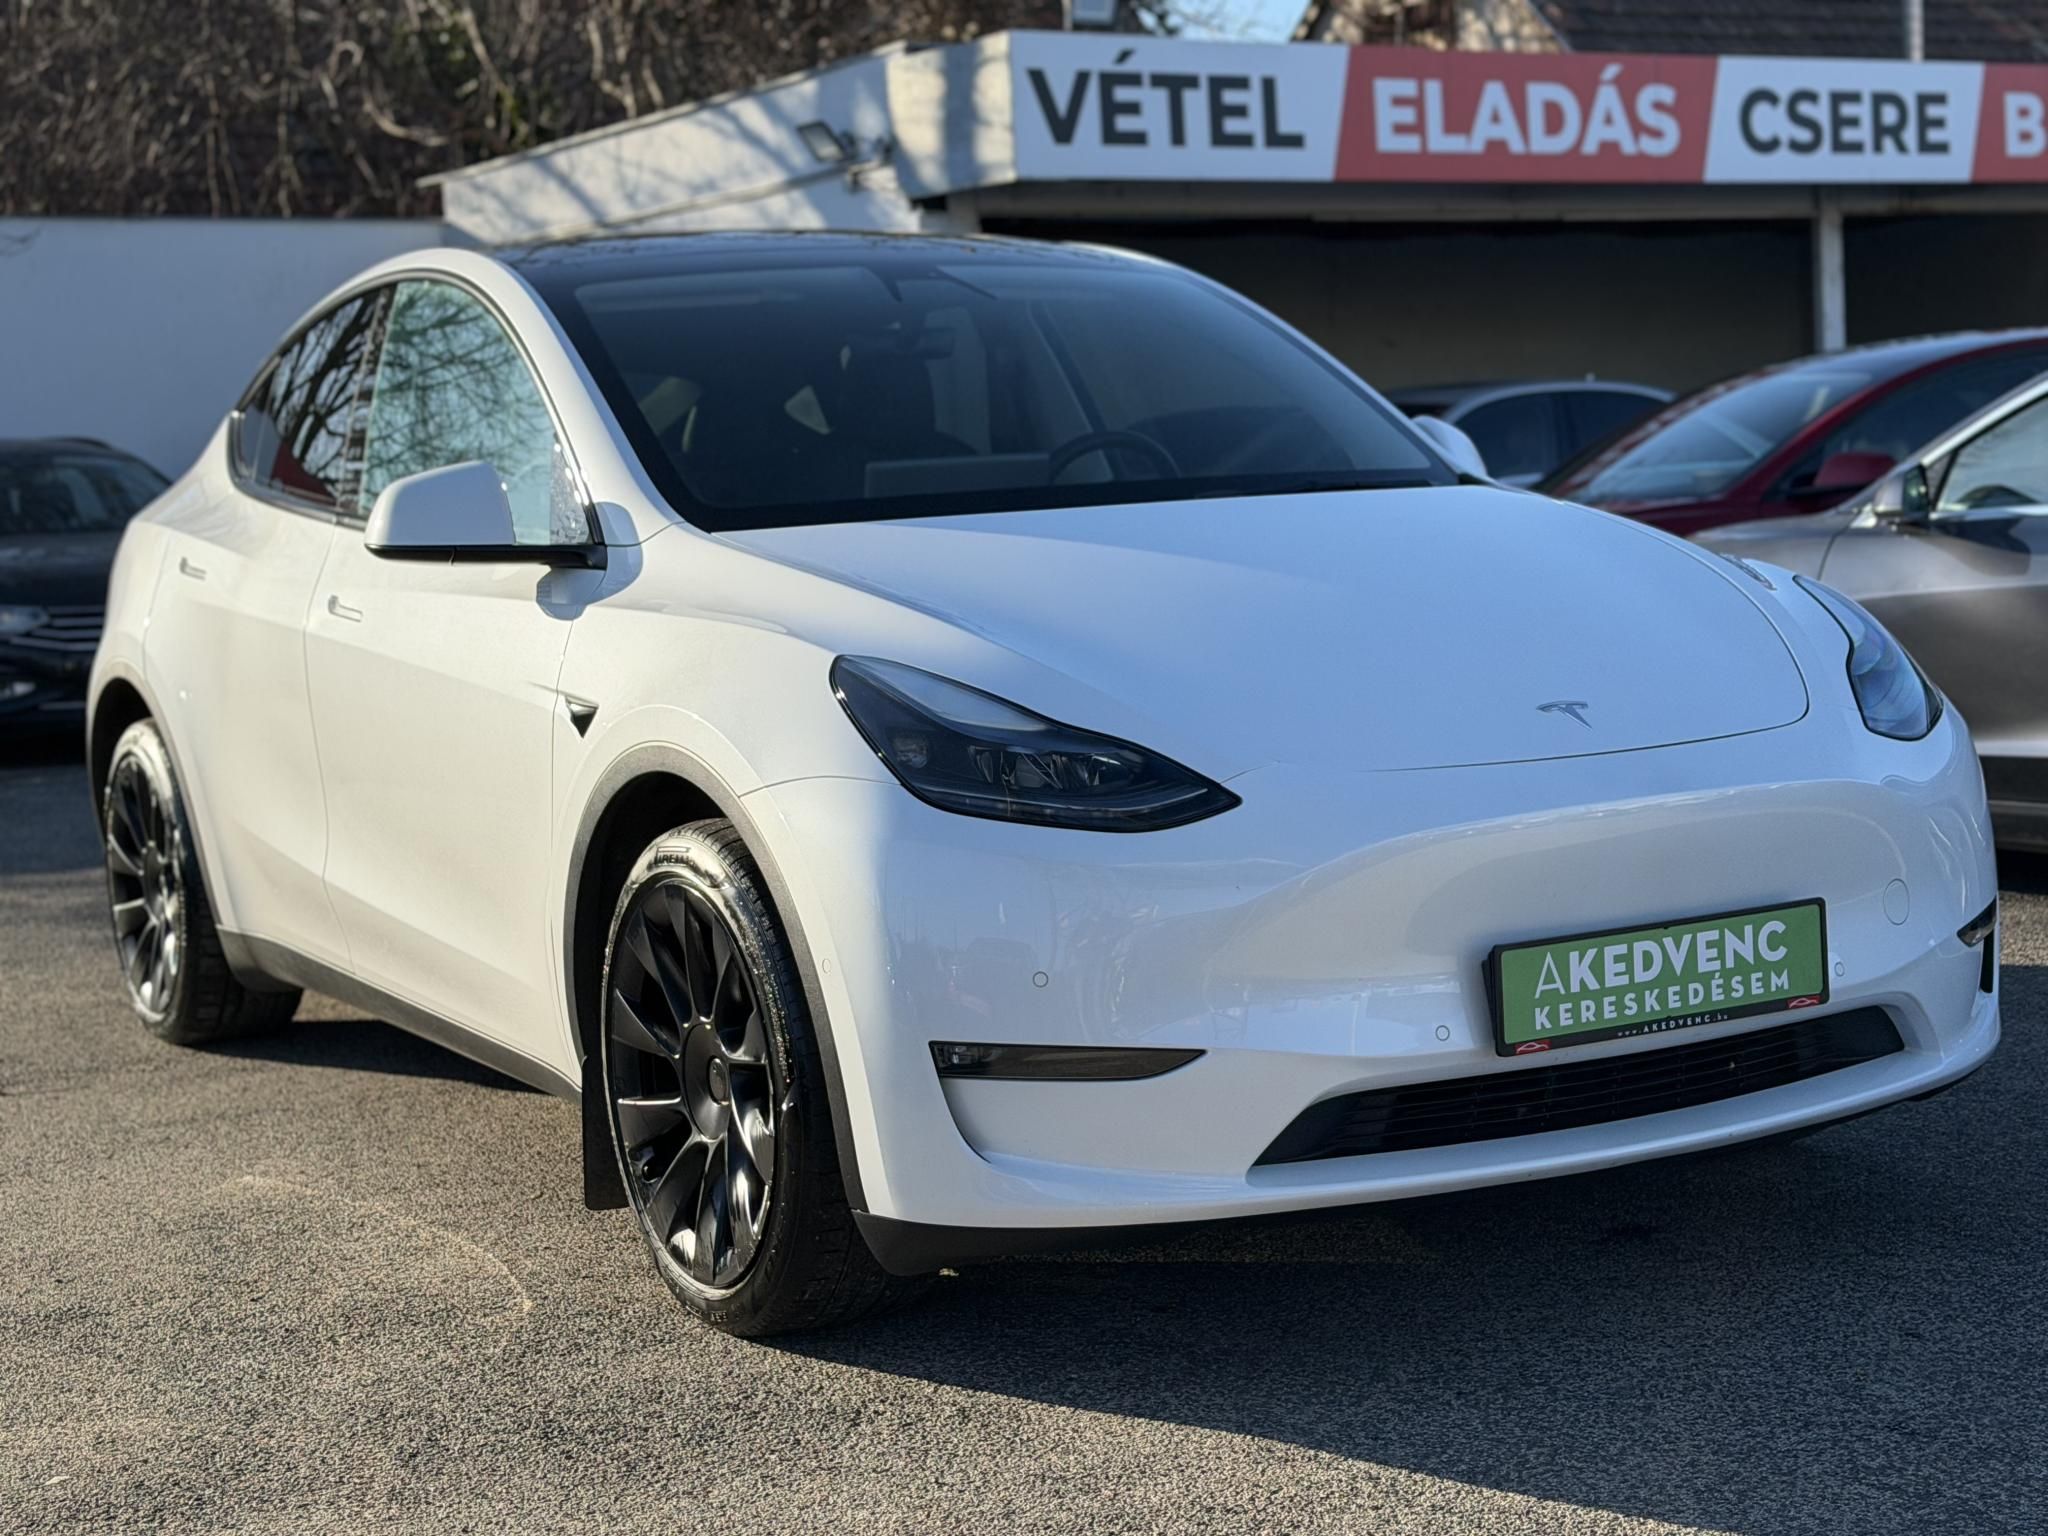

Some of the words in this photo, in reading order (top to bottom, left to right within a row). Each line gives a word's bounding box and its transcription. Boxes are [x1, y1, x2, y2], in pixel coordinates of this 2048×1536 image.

[1027, 51, 1305, 148] VÉTEL
[1373, 64, 1681, 157] ELADÁS
[1739, 87, 1950, 155] CSERE
[1534, 969, 1790, 1030] KERESKEDÉSEM
